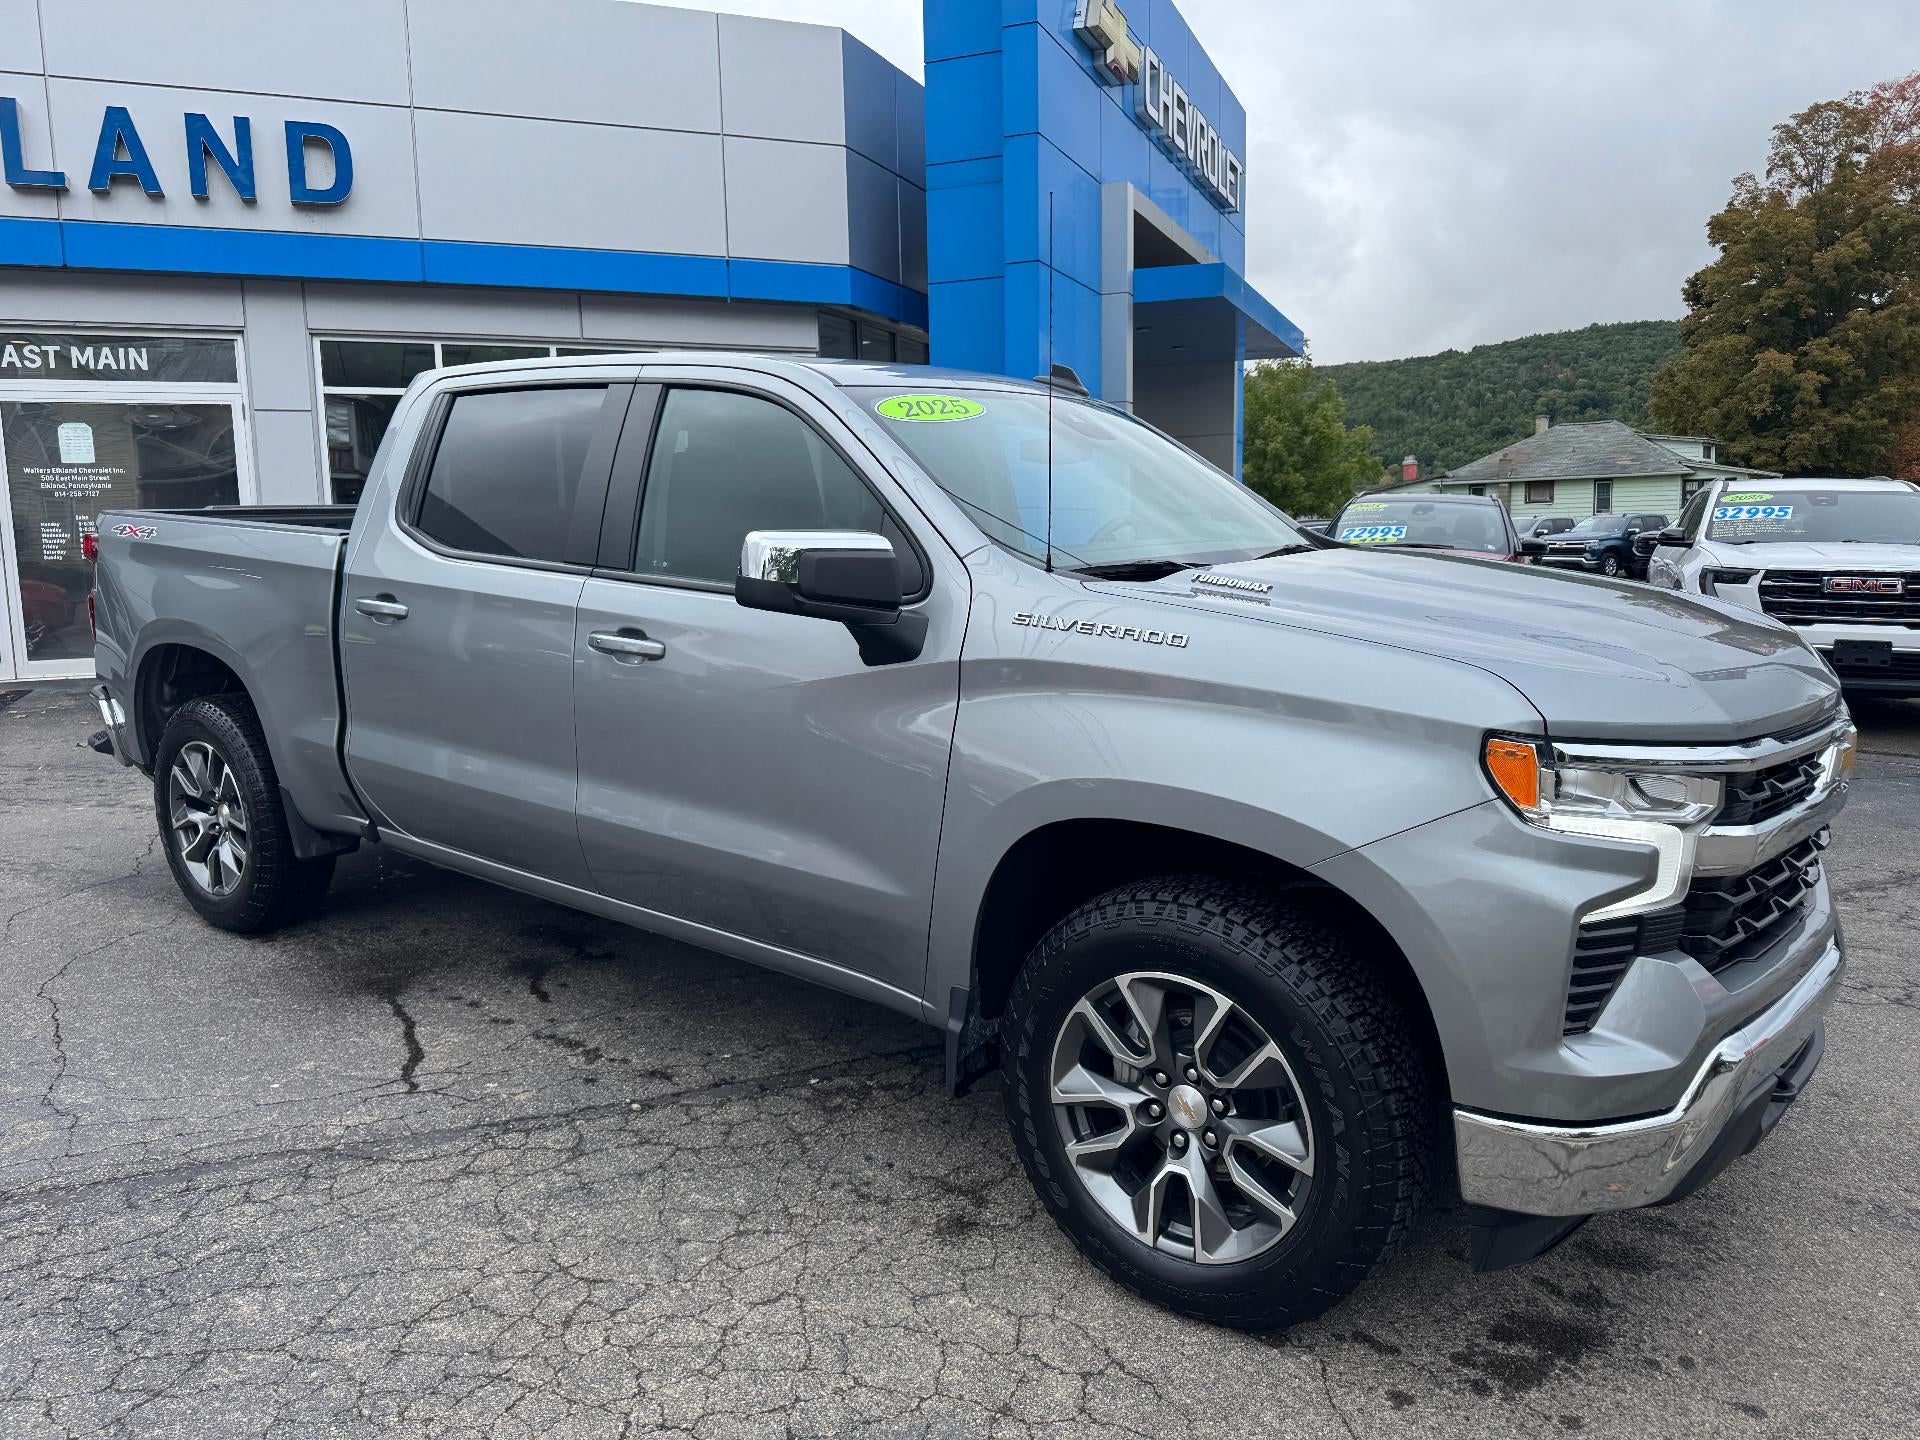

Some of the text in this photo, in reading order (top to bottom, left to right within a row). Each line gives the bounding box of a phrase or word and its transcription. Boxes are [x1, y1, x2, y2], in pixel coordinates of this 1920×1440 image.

[1138, 45, 1243, 214] CHEVROLET
[0, 96, 355, 208] LAND
[0, 344, 149, 371] AST MAIN
[898, 399, 970, 418] 2025
[1713, 506, 1792, 520] 32995
[1341, 526, 1406, 540] 22995
[1191, 572, 1272, 593] TURBOMAX
[1829, 578, 1902, 592] GMC
[1012, 611, 1189, 648] SILVERADO
